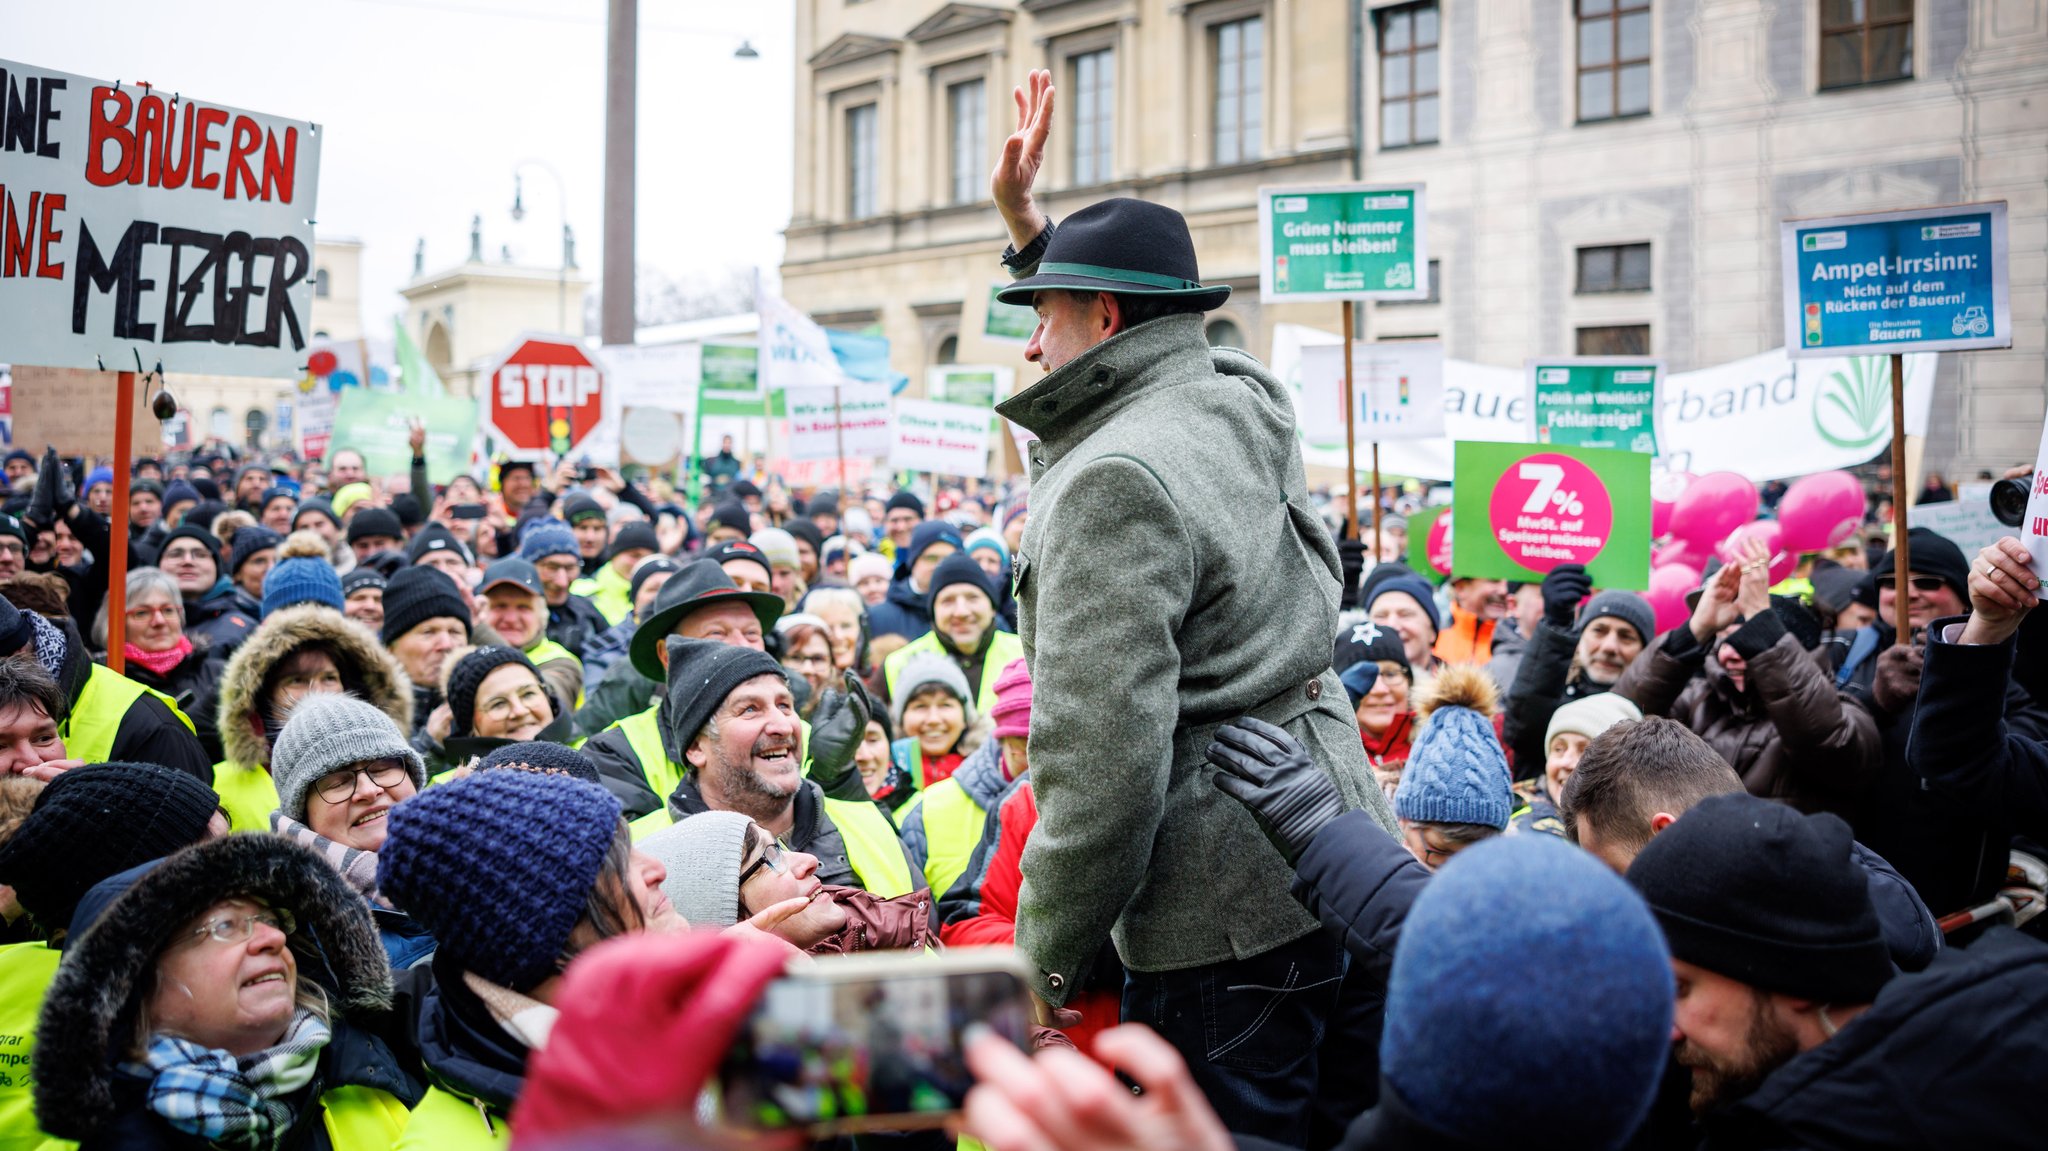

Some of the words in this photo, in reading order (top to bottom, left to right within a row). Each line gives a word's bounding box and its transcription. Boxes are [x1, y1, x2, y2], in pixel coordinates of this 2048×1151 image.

[0, 67, 67, 159] NE
[85, 85, 297, 205] BAUERN
[1283, 220, 1331, 237] Grüne
[1334, 219, 1404, 236] Nummer
[1289, 242, 1330, 256] muss
[1332, 237, 1398, 255] bleiben!
[0, 184, 66, 280] NE
[72, 217, 310, 352] METZGER
[1811, 251, 1979, 283] Ampel-Irrsinn:
[1843, 283, 1882, 299] Nicht
[1885, 280, 1909, 295] auf
[1912, 280, 1945, 294] dem
[1824, 298, 1877, 315] Rücken
[1880, 297, 1904, 310] der
[1908, 291, 1966, 308] Bauern!
[1869, 327, 1922, 342] Bauern
[499, 364, 600, 408] STOP
[1547, 408, 1642, 431] Fehlanzeige!
[1518, 462, 1584, 517] 7%
[1516, 515, 1558, 531] MwSt.
[1560, 519, 1584, 532] auf
[1498, 528, 1549, 543] Speisen
[1549, 532, 1602, 548] müssen
[1521, 544, 1576, 560] bleiben.
